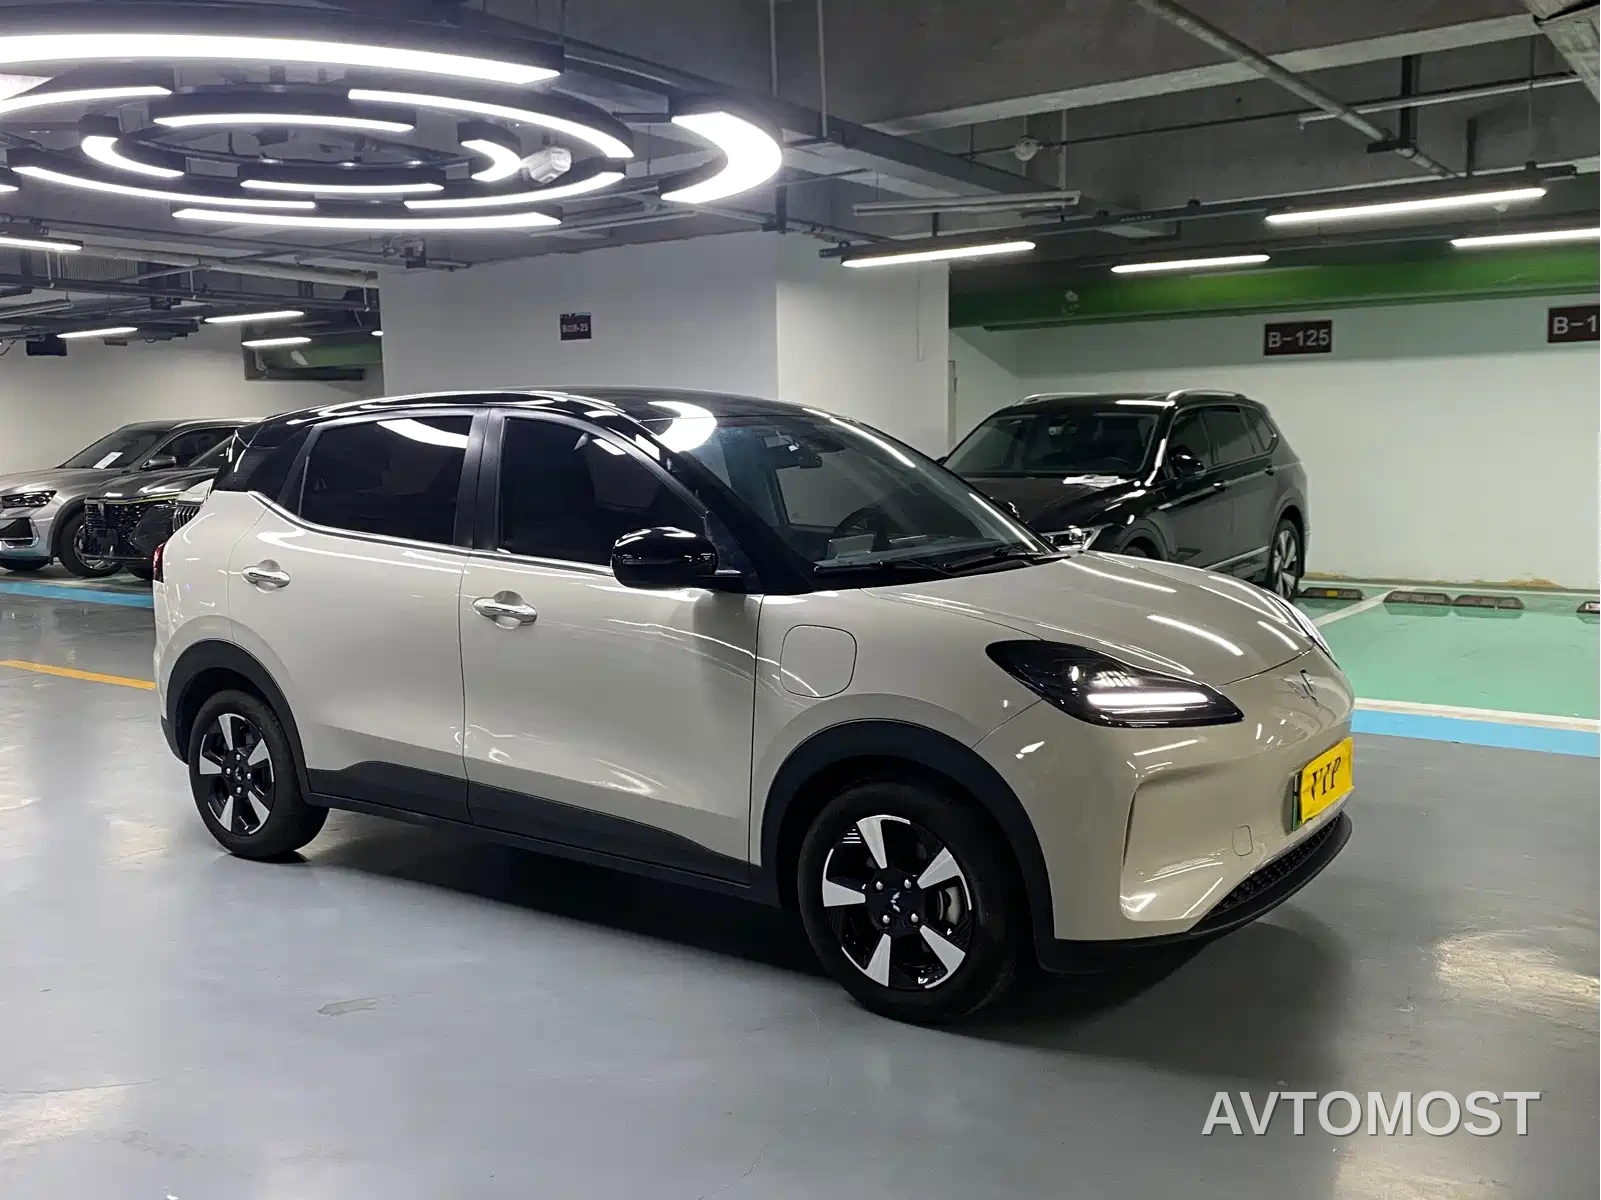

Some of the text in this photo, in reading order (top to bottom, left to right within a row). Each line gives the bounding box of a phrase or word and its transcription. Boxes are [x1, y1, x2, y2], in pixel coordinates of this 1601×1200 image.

[1553, 314, 1597, 335] B-1
[1267, 328, 1330, 348] B-125
[1310, 755, 1342, 802] VIP
